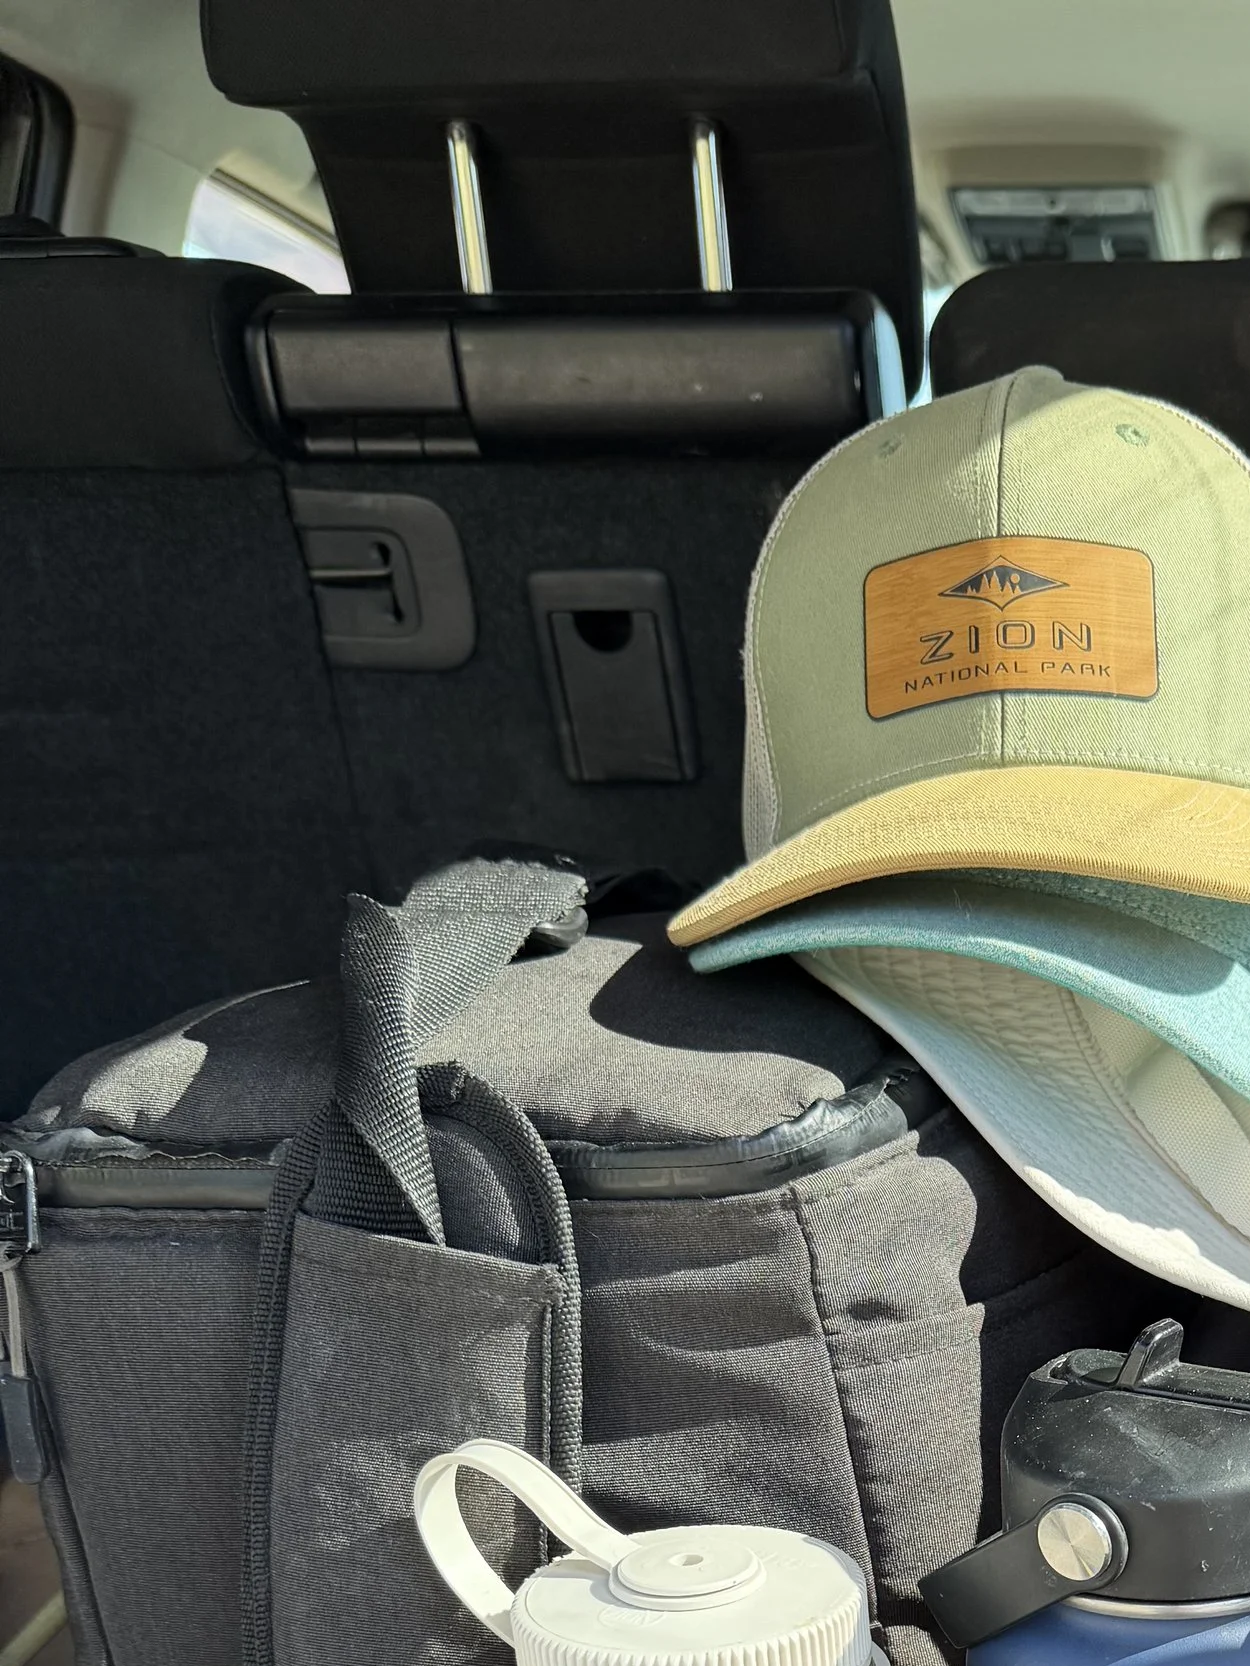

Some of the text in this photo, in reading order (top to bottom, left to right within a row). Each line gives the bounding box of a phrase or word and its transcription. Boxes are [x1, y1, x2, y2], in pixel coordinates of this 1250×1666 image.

[919, 620, 1092, 664] ZION
[904, 661, 1111, 693] NATIONAL PARK
